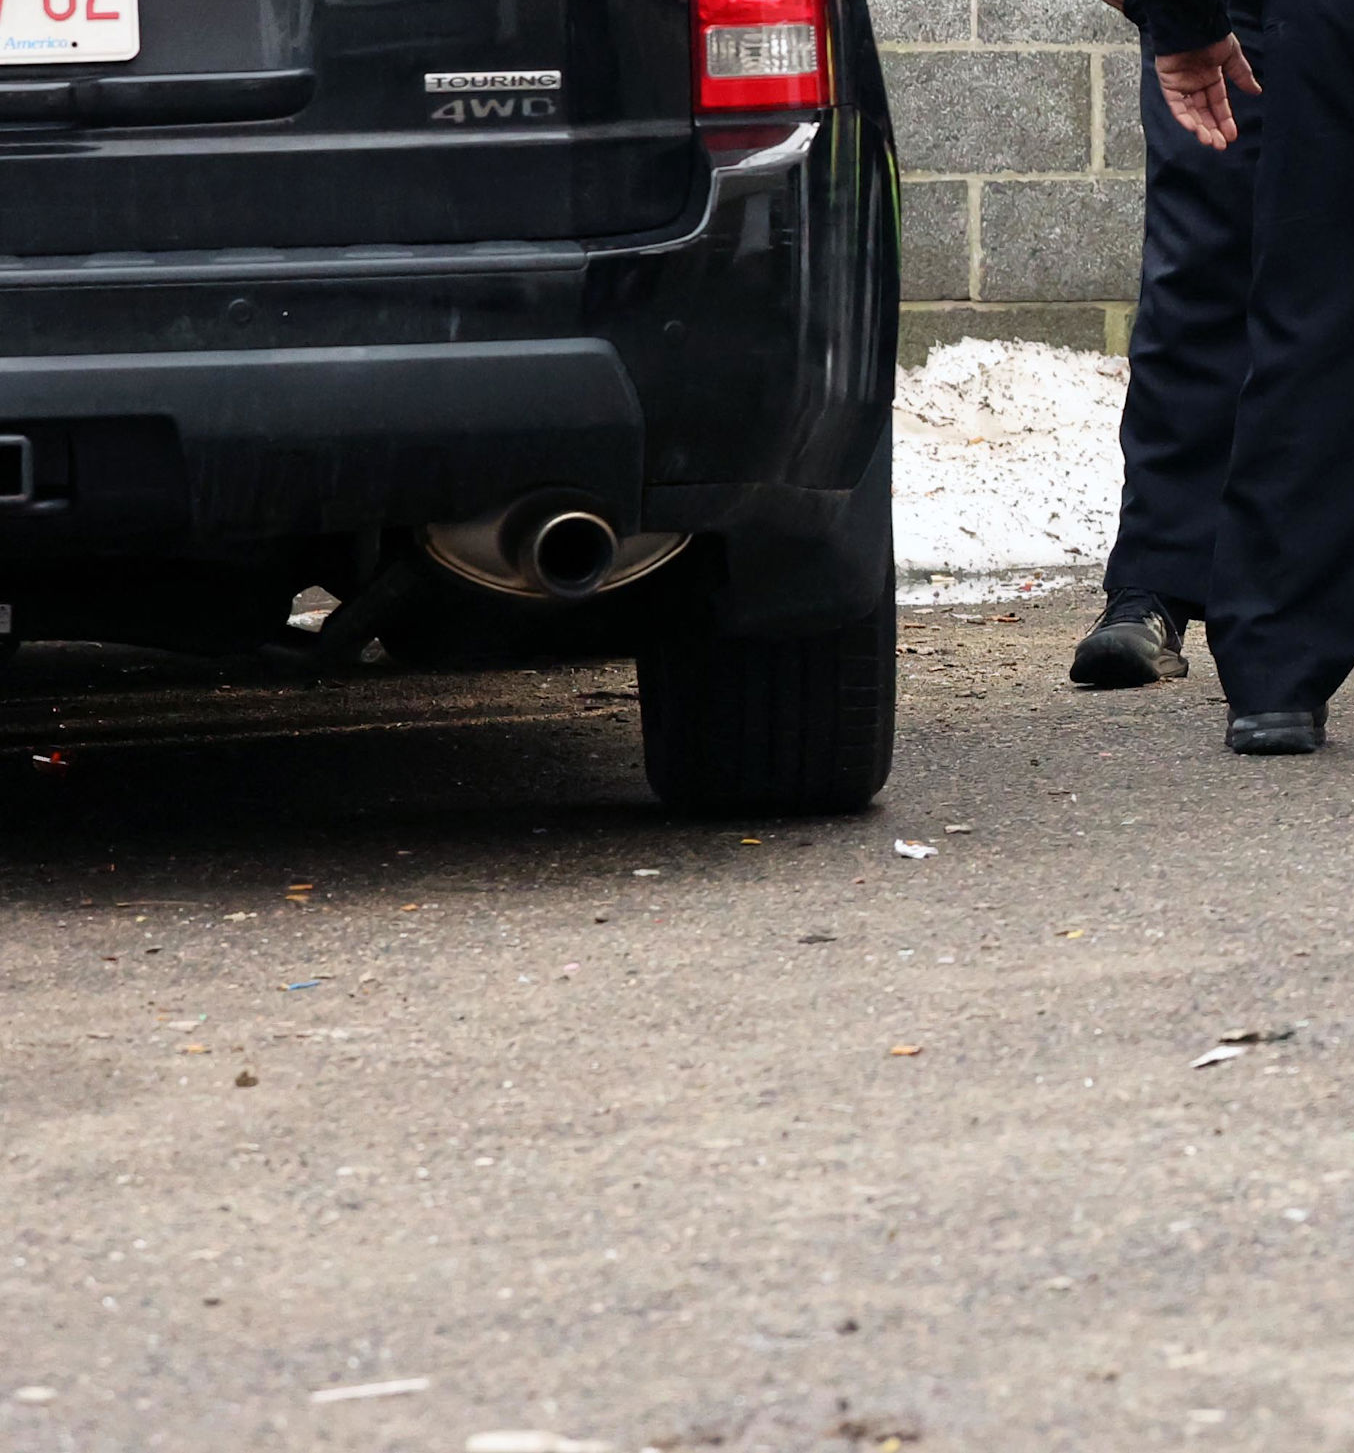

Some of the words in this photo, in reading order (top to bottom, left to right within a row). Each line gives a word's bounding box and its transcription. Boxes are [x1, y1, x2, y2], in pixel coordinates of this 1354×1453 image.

[3, 36, 69, 50] America
[431, 75, 557, 89] TOURING
[430, 97, 557, 124] 4WD
